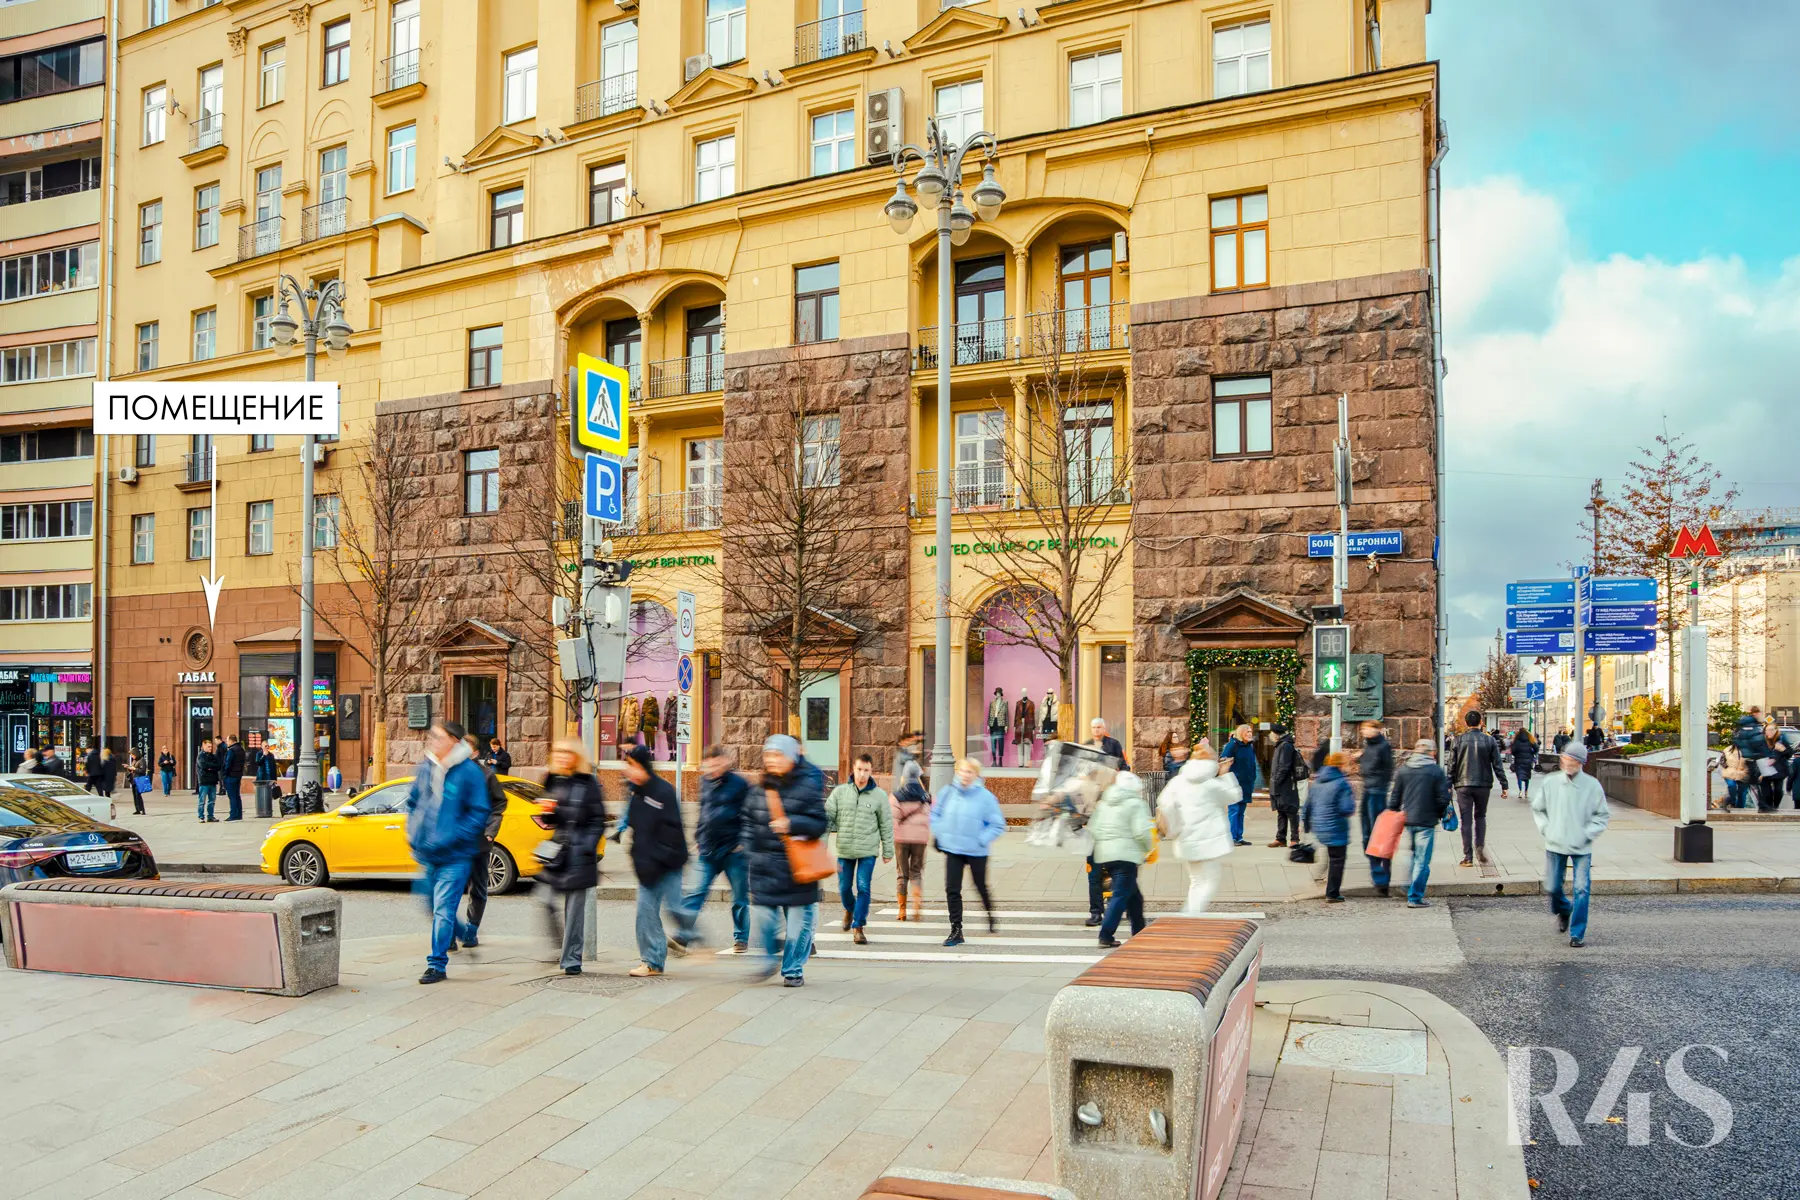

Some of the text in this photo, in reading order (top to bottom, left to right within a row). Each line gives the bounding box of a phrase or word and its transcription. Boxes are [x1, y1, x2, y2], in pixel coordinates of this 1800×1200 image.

[1027, 540, 1045, 552] OF
[1357, 536, 1399, 546] БРОННАЯ
[683, 617, 690, 629] 30
[177, 671, 216, 682] ТАБАК
[51, 701, 93, 716] ТАБАК
